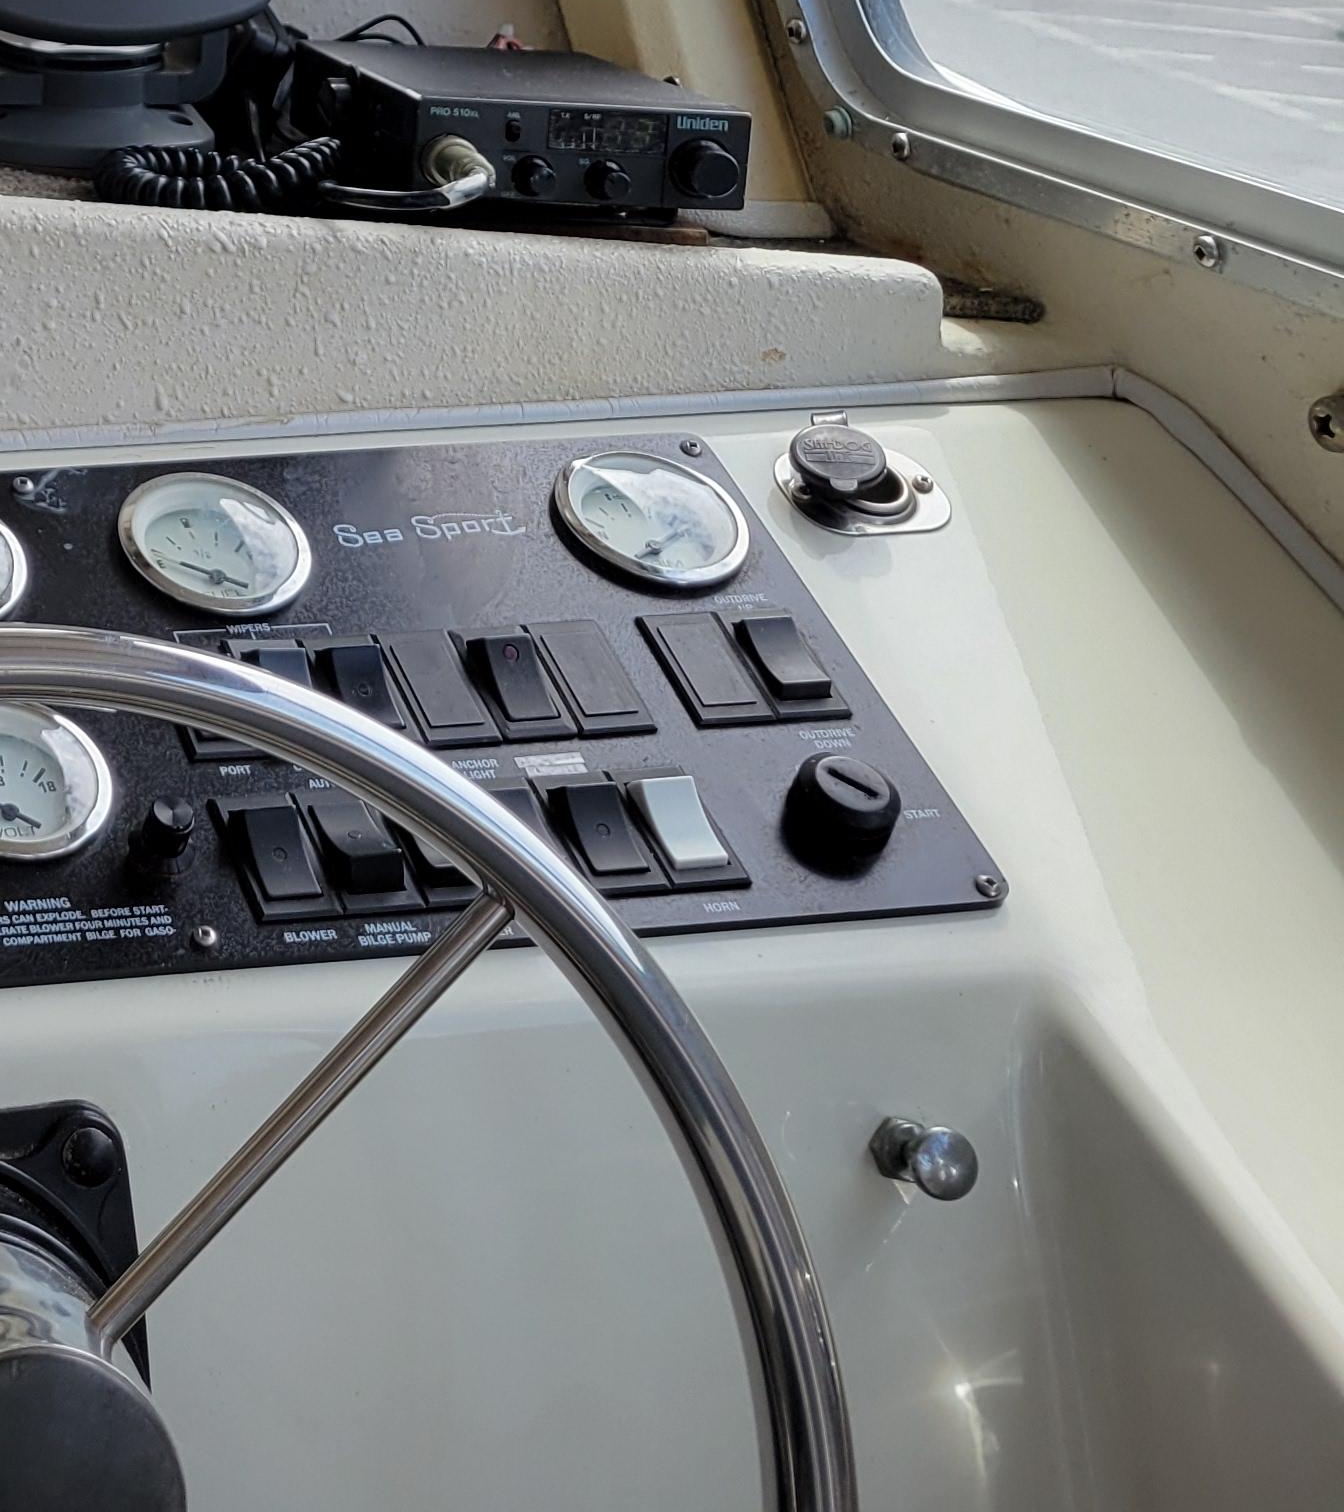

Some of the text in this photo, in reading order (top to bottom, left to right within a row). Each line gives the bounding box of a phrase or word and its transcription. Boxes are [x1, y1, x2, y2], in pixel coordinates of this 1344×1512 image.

[430, 107, 451, 116] PRO
[677, 116, 729, 132] Uniden
[333, 509, 526, 548] Sea Sport
[713, 593, 768, 604] OUTDRIVE
[226, 622, 271, 635] WIPERS
[798, 728, 856, 740] OUTDRIVE
[815, 738, 852, 749] DOWN
[219, 764, 252, 777] PORT
[451, 759, 499, 769] ANCHOR
[39, 781, 56, 793] 18
[904, 809, 941, 819] START
[4, 897, 71, 913] WARNING
[703, 901, 740, 913] HORN
[12, 913, 34, 924] CAN
[91, 907, 131, 919] BEFORE
[30, 921, 73, 934] BLOWER
[75, 919, 103, 930] FOUR
[104, 916, 149, 928] MINUTES
[150, 914, 172, 924] AND
[364, 920, 417, 934] MANUAL
[3, 932, 82, 946] COMPARTMENT
[85, 929, 117, 941] BILGE
[119, 928, 142, 938] FOR
[284, 929, 338, 943] BLOWER
[358, 931, 432, 947] BILGE PUMP
